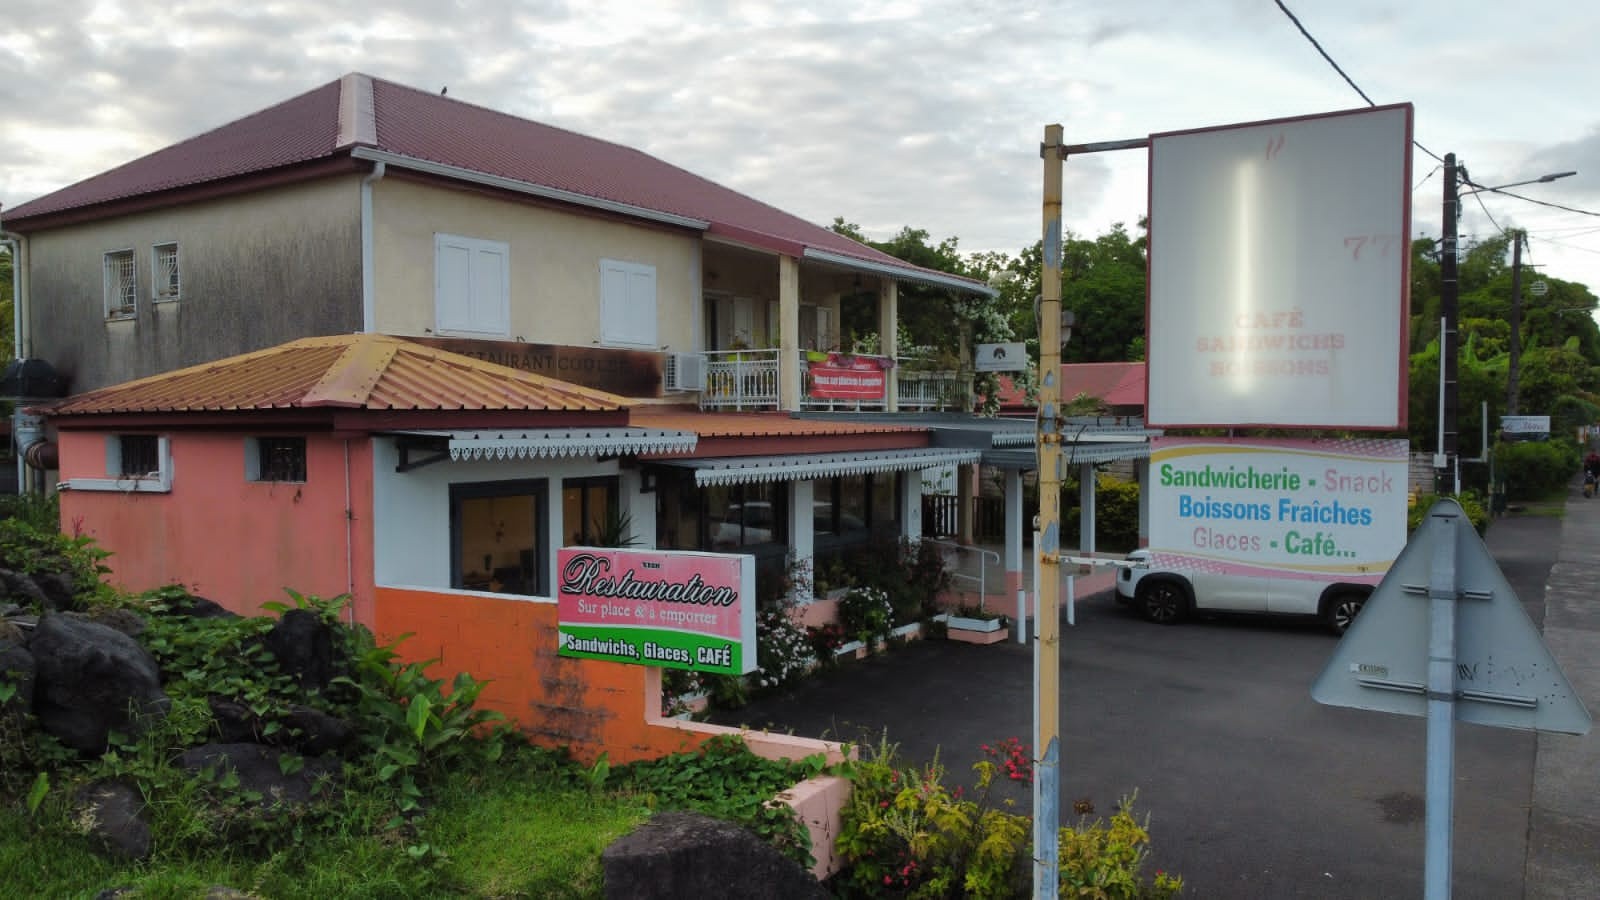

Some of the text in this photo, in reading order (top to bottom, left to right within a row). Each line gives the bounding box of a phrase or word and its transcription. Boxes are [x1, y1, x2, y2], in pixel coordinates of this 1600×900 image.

[1160, 464, 1393, 494] Sandwicherie Snack
[1179, 495, 1372, 526] Boissons Fraîches
[1193, 526, 1261, 552] Glaces
[560, 554, 738, 607] Restauration
[577, 600, 597, 614] Sur
[601, 602, 631, 618] place
[659, 608, 718, 625] emporter
[566, 634, 731, 666] Sandwichs, Glaces, CAFÉ
